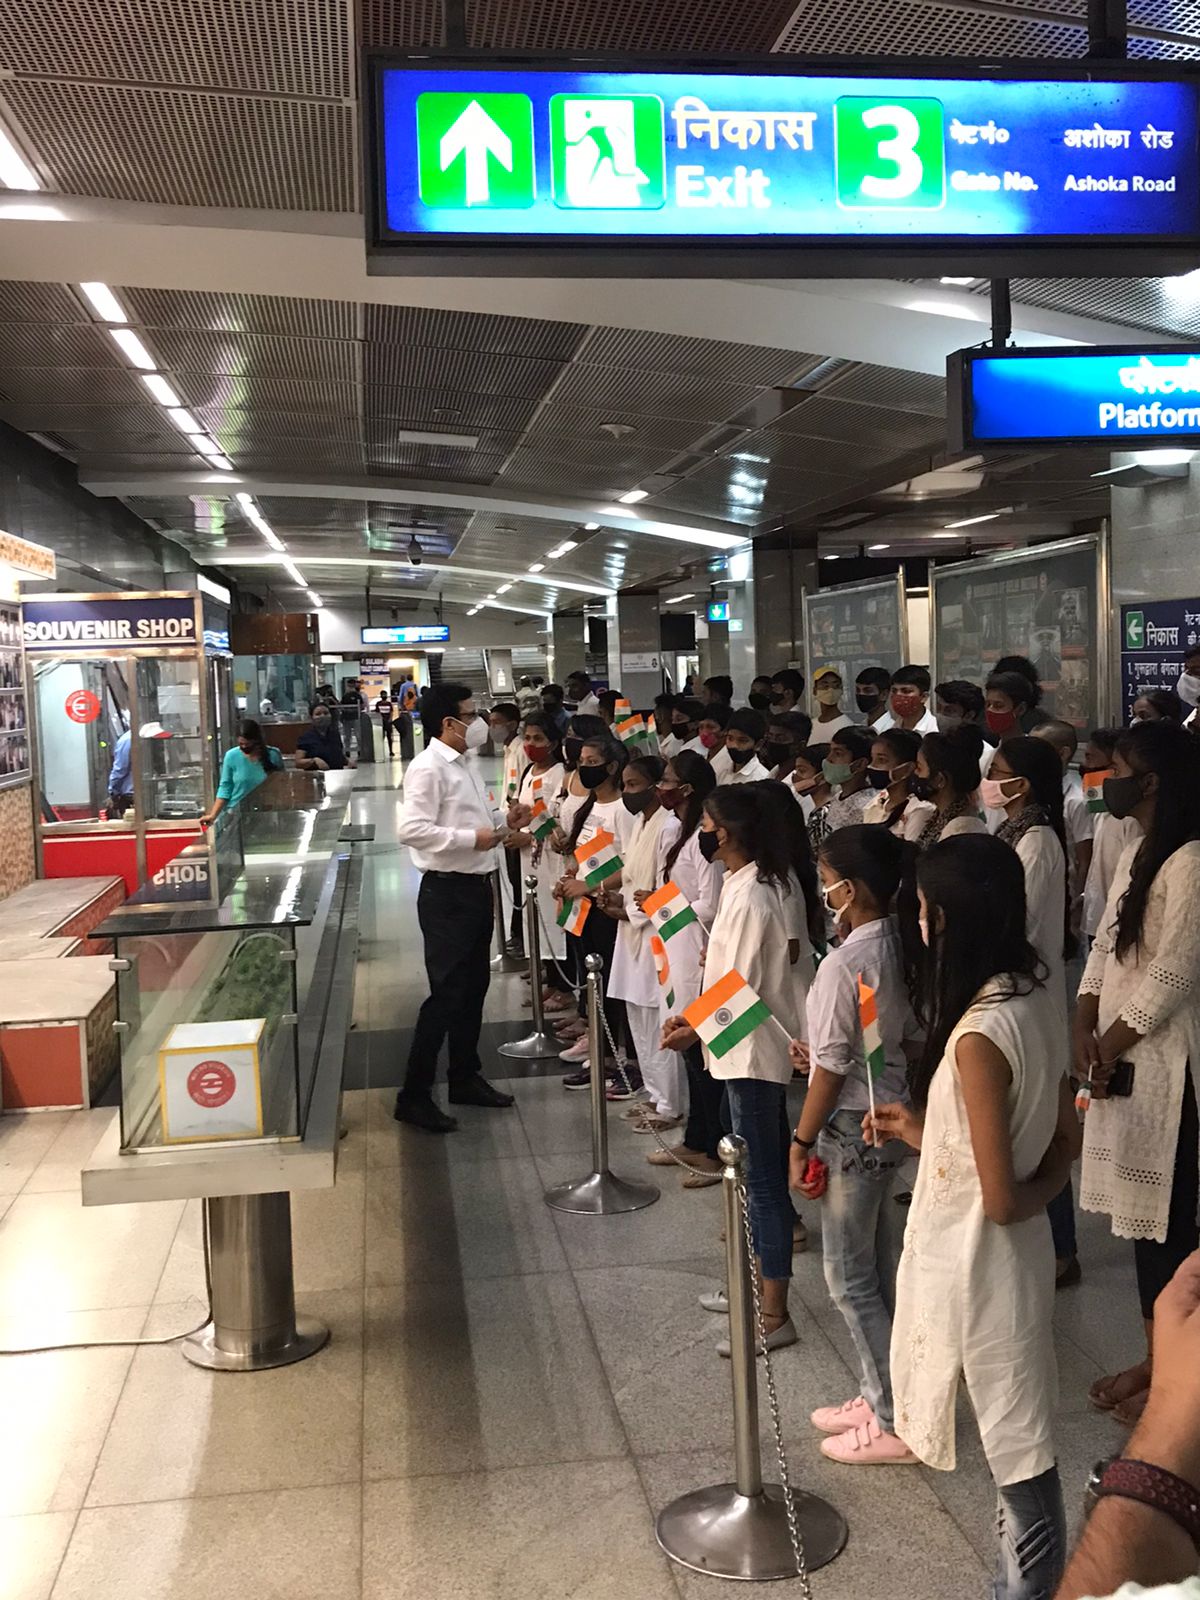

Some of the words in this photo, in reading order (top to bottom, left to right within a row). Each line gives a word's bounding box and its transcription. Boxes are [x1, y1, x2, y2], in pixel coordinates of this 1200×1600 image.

[671, 95, 817, 150] निकास
[1064, 123, 1131, 149] अशोका
[1140, 124, 1175, 149] रोड
[860, 105, 924, 199] 3
[675, 165, 771, 208] Exit
[1064, 175, 1128, 191] Ashoka
[1132, 176, 1176, 192] Road
[24, 620, 132, 641] SOUVENIR
[137, 618, 193, 638] SHOP
[1146, 621, 1180, 646] निकास
